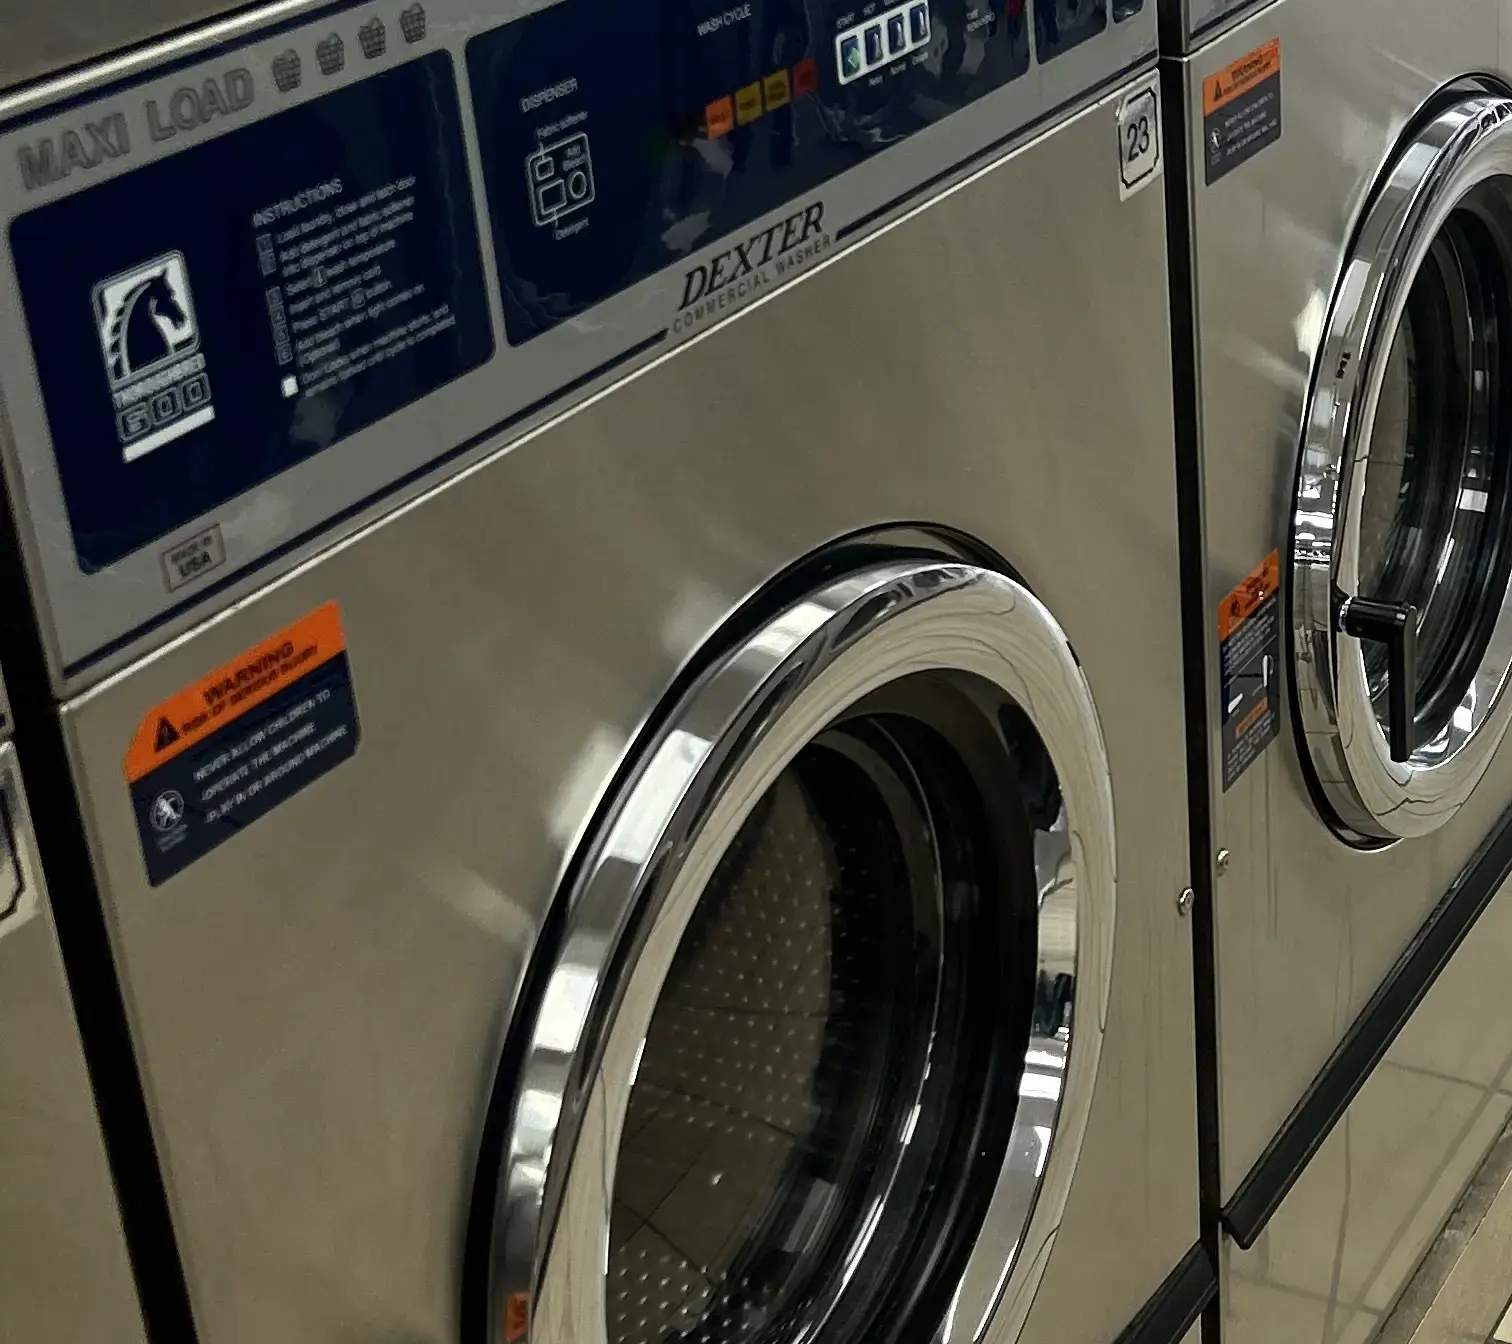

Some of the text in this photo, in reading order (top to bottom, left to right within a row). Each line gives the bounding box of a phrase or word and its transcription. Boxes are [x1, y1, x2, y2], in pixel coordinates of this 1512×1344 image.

[697, 3, 752, 37] WASH CYCLE
[520, 77, 578, 114] DISPENSER
[17, 66, 255, 191] MAXI LOAD
[1126, 115, 1150, 163] 23
[677, 200, 825, 312] DEXTER
[672, 233, 833, 334] COMMERCIAL WASHER
[119, 378, 207, 439] 600
[179, 552, 212, 578] USA
